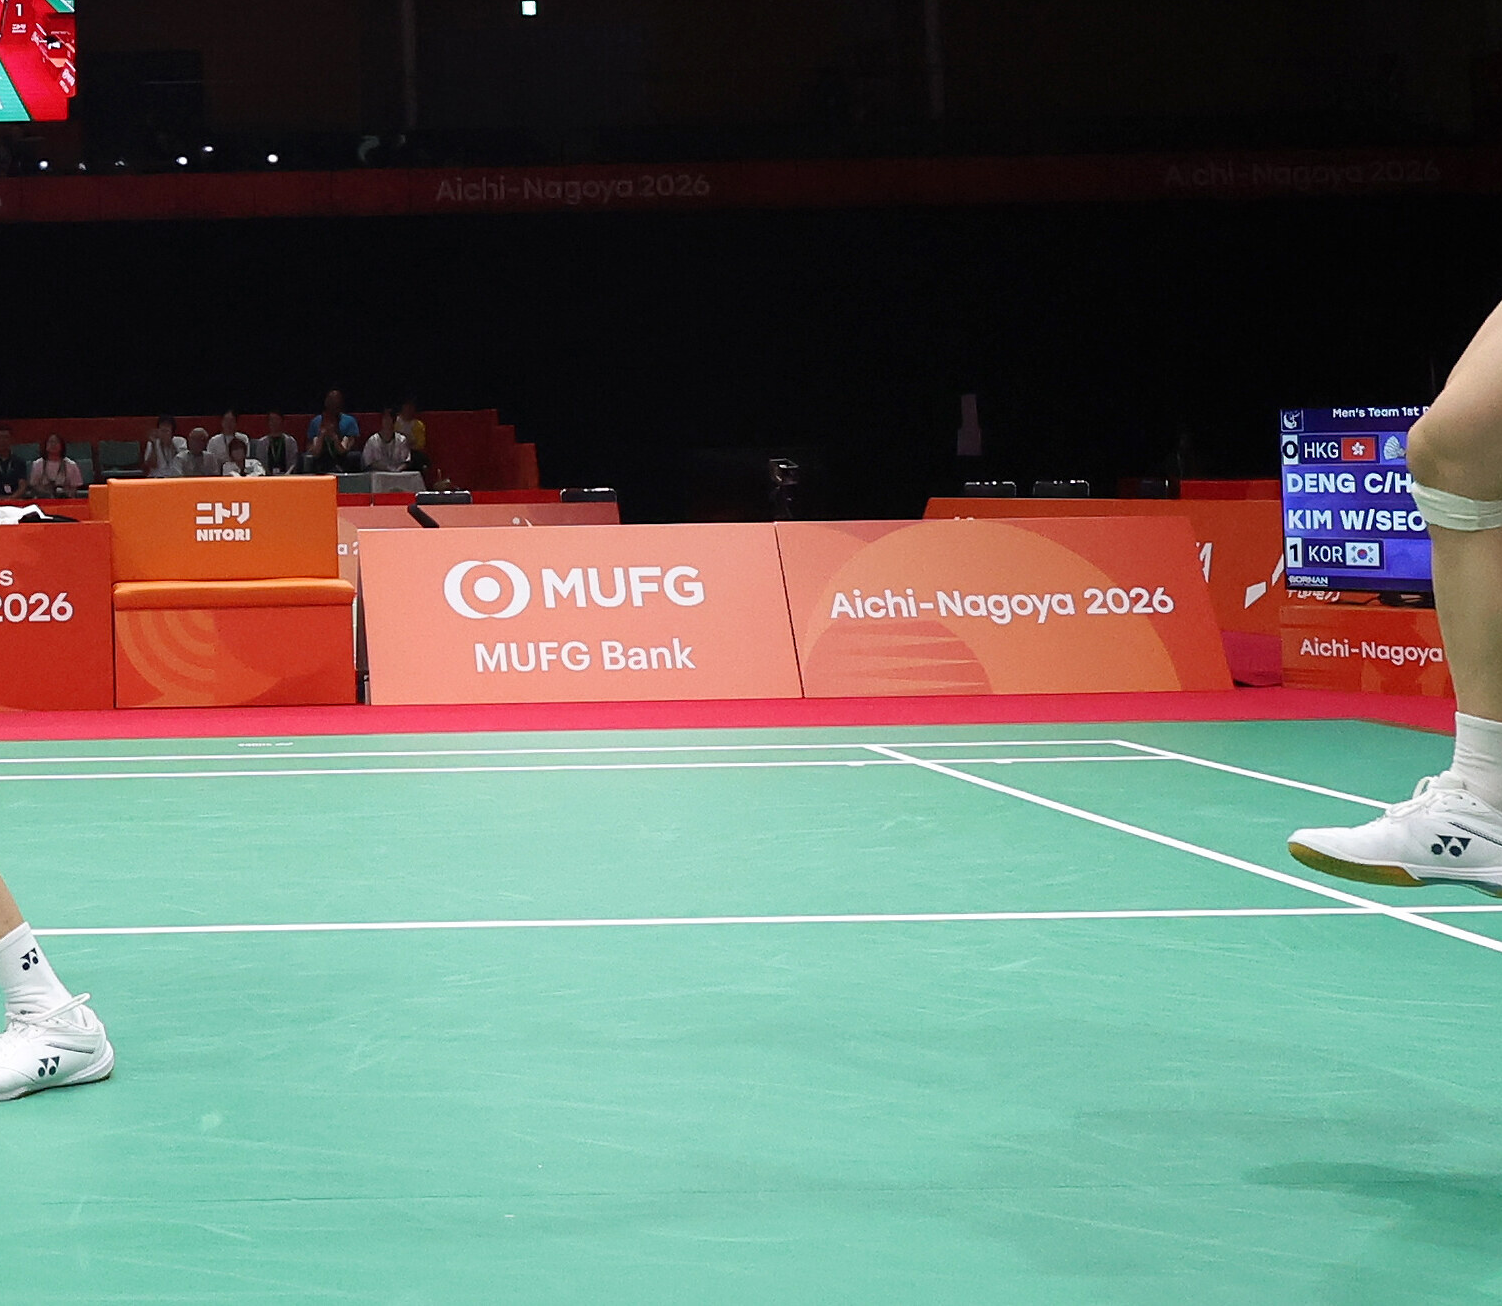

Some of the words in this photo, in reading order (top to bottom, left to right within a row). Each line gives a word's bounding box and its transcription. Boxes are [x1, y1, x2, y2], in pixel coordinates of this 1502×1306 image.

[15, 3, 22, 16] 1
[436, 175, 634, 205] Aichi-Nagoya
[640, 173, 711, 196] 2026
[1332, 407, 1366, 419] Men's
[1367, 407, 1400, 418] Team
[1402, 406, 1420, 417] 1st
[1304, 442, 1339, 459] HKG
[1286, 472, 1357, 494] DENG
[195, 502, 251, 525] ニトリ
[1287, 509, 1333, 531] KIM
[195, 528, 251, 542] NITORI
[1289, 543, 1299, 563] 1
[1308, 545, 1344, 563] KOR
[540, 565, 705, 608] MUFG
[830, 588, 1076, 625] Aichi-Nagoya
[1083, 587, 1175, 615] 2026
[474, 640, 591, 673] MUFG
[601, 637, 697, 671] Bank
[1300, 637, 1444, 667] Aichi-Nagoya
